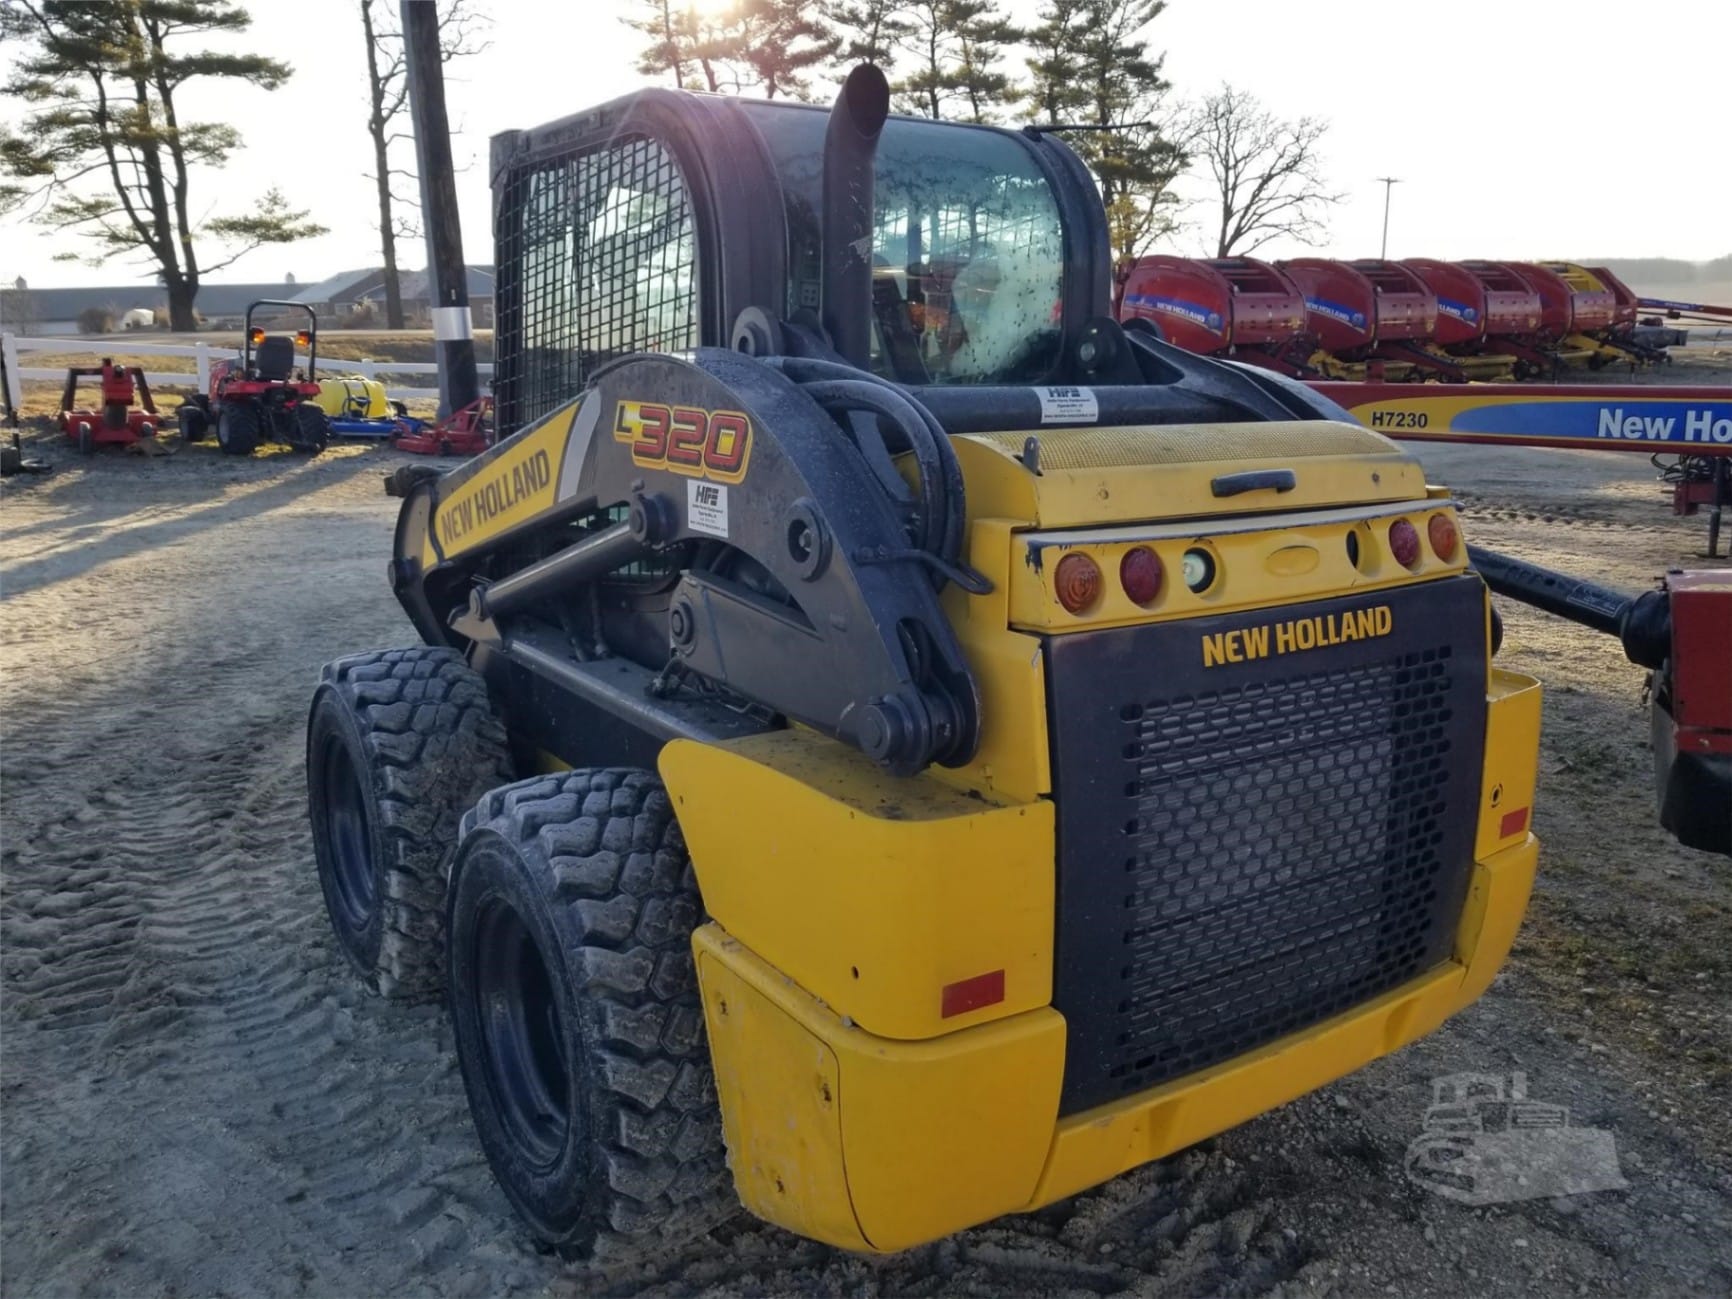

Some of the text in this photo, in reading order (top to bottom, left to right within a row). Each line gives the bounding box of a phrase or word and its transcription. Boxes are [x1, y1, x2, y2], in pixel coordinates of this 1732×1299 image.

[1438, 304, 1461, 317] LLAND
[614, 402, 752, 482] L320
[1371, 411, 1428, 428] H7230
[1599, 408, 1676, 440] New
[440, 447, 551, 546] NEW HOLLAND
[1201, 605, 1393, 668] NEW HOLLAND
